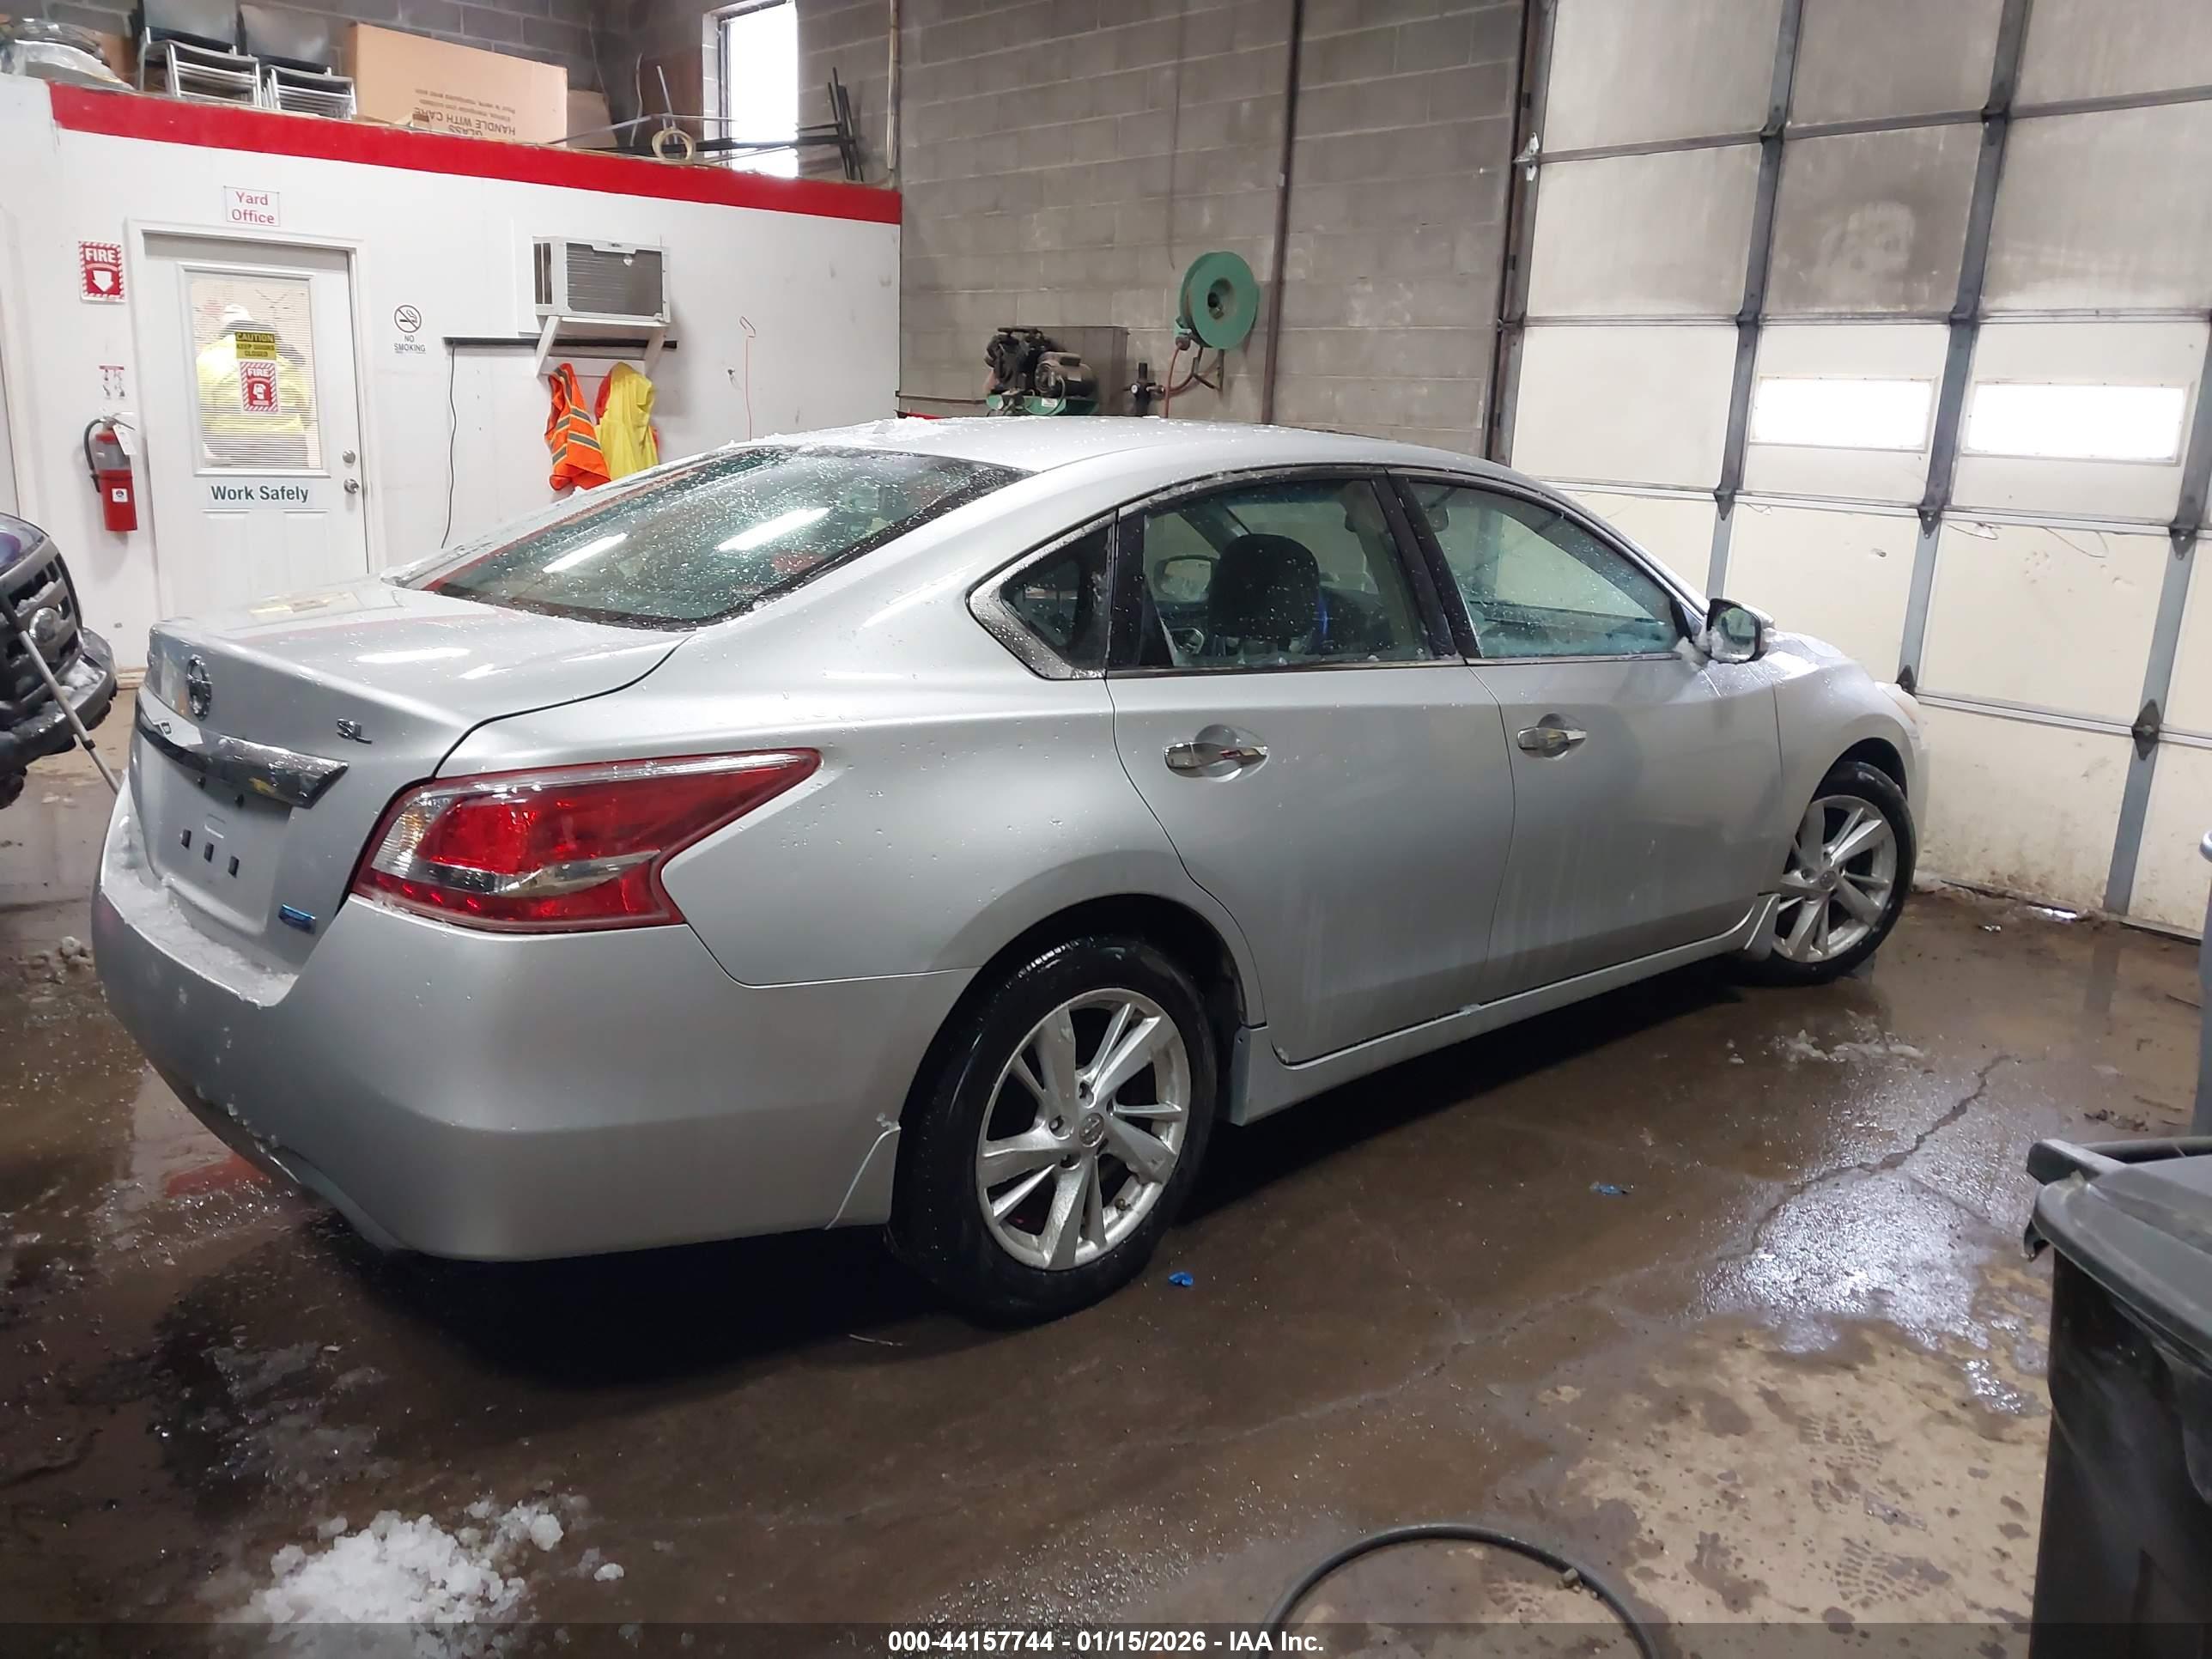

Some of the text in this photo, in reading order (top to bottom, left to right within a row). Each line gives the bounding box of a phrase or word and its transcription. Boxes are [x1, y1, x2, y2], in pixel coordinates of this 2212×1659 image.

[447, 114, 472, 127] WITH
[476, 119, 515, 136] HANDLE
[448, 125, 483, 137] GLASS
[235, 191, 268, 206] Yard
[232, 209, 275, 224] Office
[85, 247, 117, 263] FIRE
[236, 333, 274, 343] CAUTION
[393, 343, 426, 352] SMOKING
[247, 368, 270, 377] FIRE
[211, 485, 308, 503] Work Safely
[337, 719, 373, 744] SL
